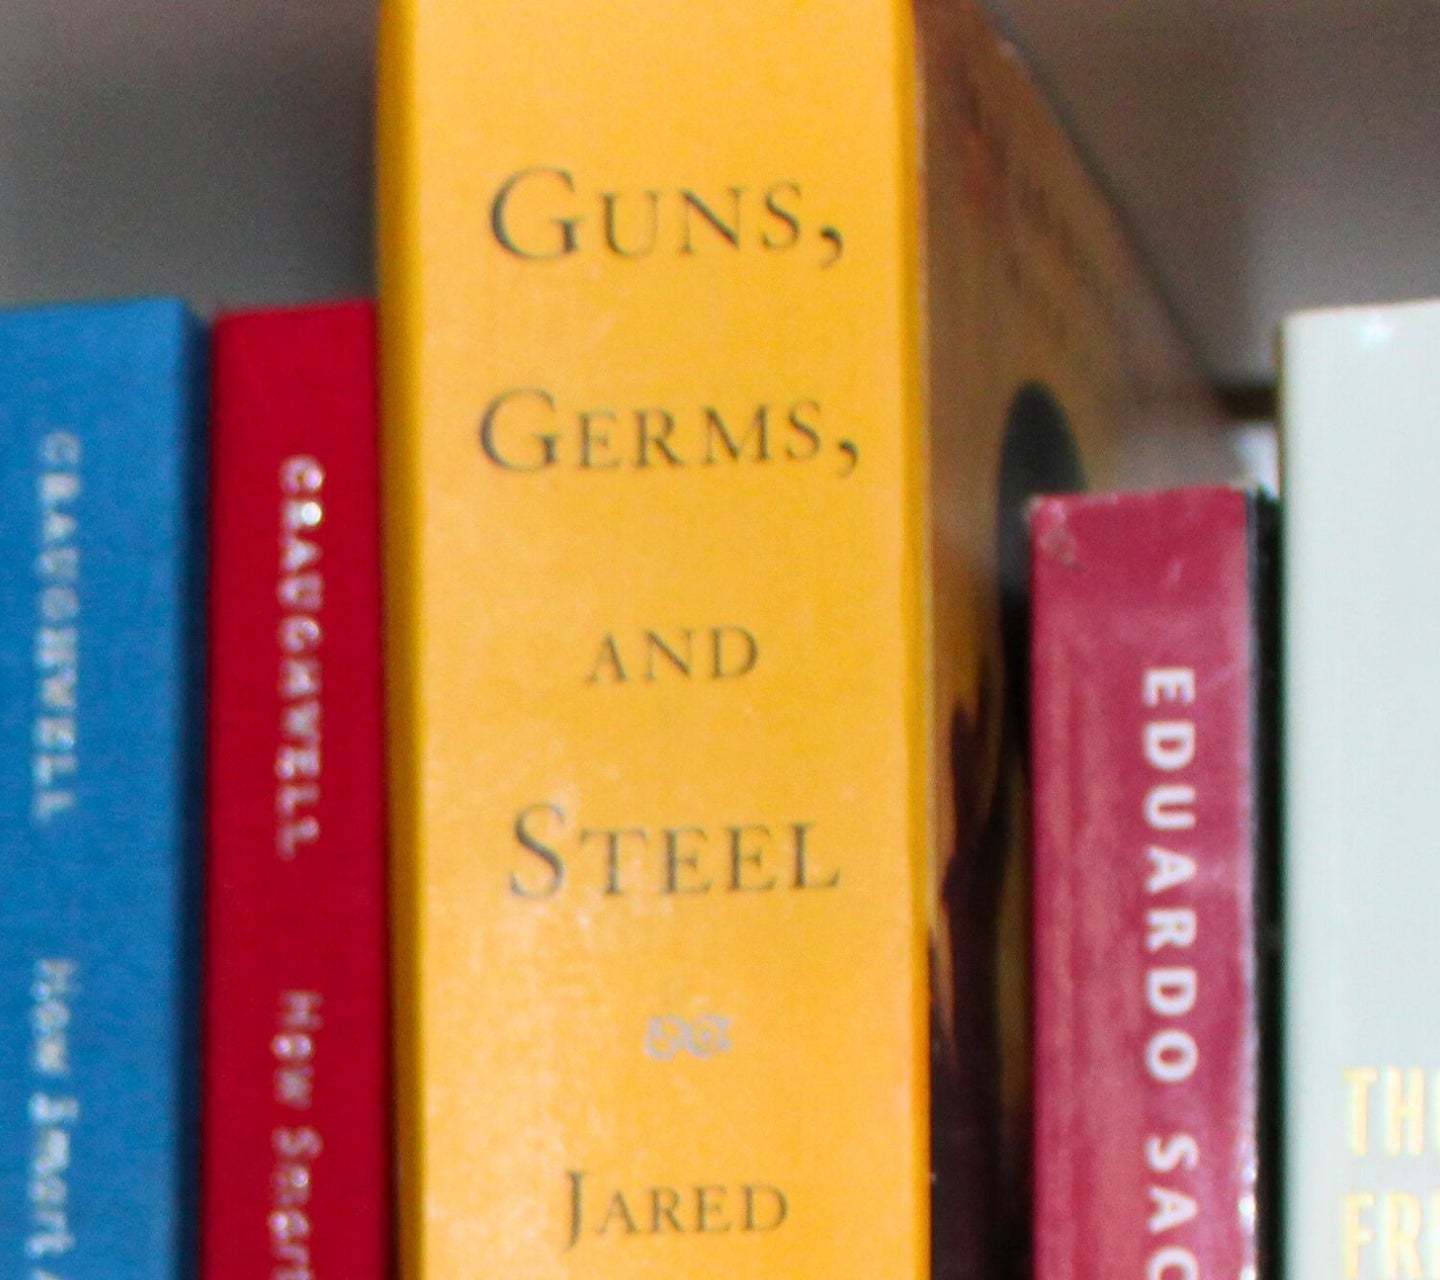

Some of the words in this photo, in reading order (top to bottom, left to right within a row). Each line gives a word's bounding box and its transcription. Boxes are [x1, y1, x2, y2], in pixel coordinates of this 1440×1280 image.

[585, 624, 759, 684] AND
[1142, 667, 1198, 1083] EDUARDO
[271, 990, 322, 1108] How
